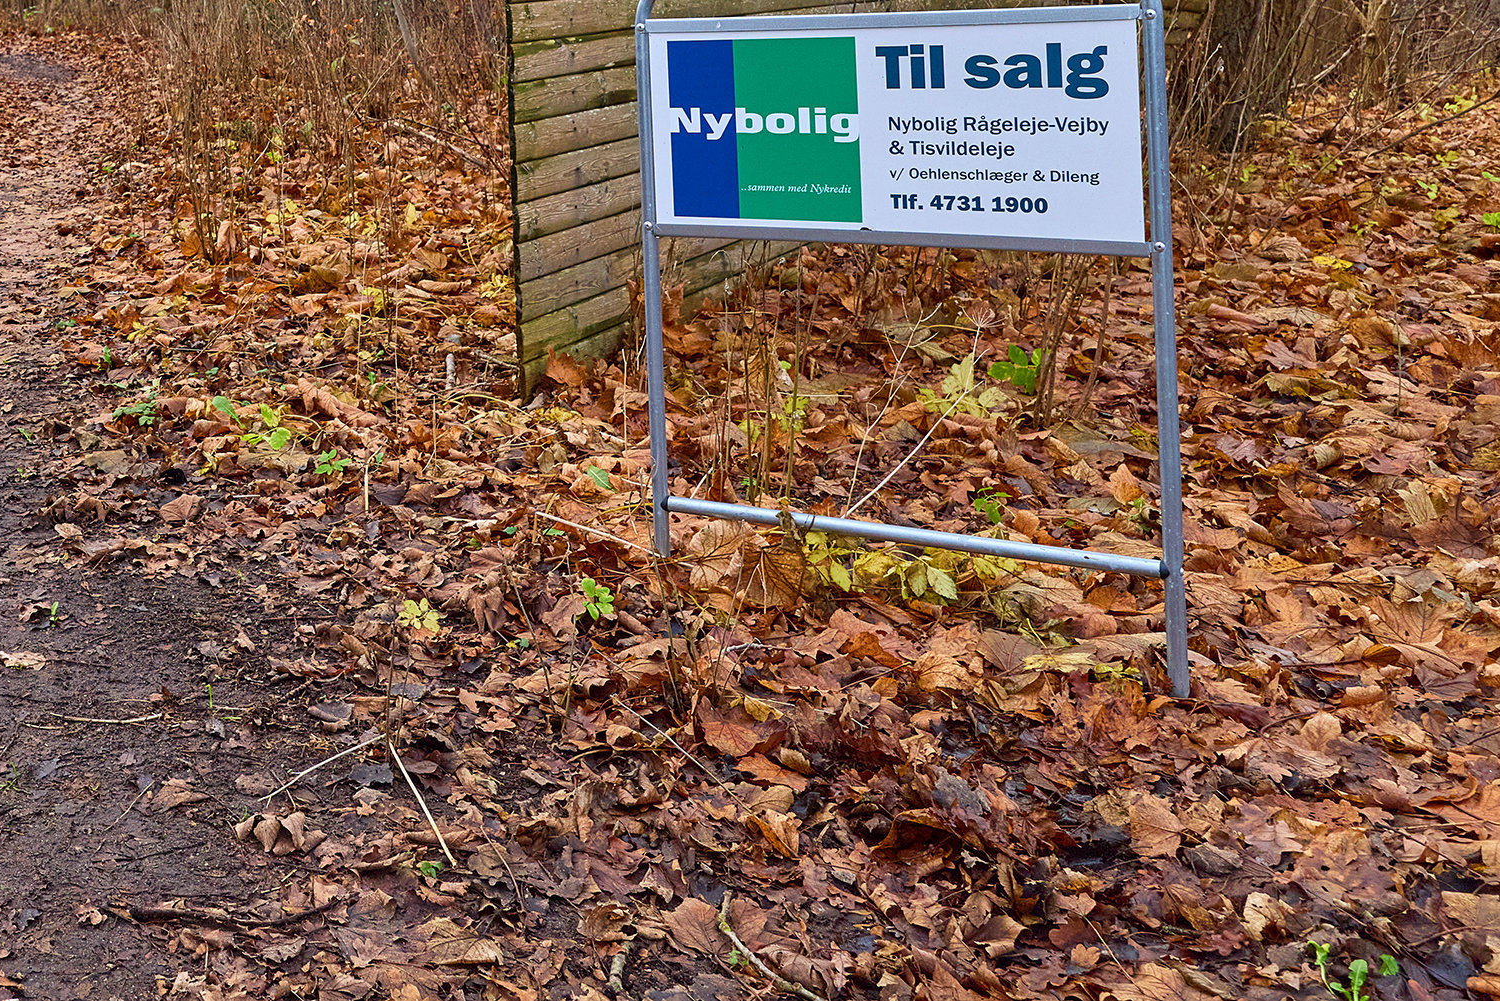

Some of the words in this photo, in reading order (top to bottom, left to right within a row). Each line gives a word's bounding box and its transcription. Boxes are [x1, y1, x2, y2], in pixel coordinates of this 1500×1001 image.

[875, 44, 945, 89] Til
[963, 43, 1109, 99] salg
[670, 107, 859, 142] Nybolig
[888, 116, 958, 135] Nybolig
[963, 116, 1109, 135] Rågeleje-Vejby
[889, 140, 904, 156] &
[909, 140, 1015, 158] Tisvildeleje
[890, 167, 904, 180] v/
[909, 167, 1028, 183] Oehlenschlæger
[1032, 169, 1045, 182] &
[1050, 169, 1099, 186] Dileng
[788, 184, 808, 193] med
[810, 183, 852, 196] Nykredit
[890, 194, 923, 210] Tlf.
[929, 195, 985, 212] 4731
[992, 197, 1048, 214] 1900
